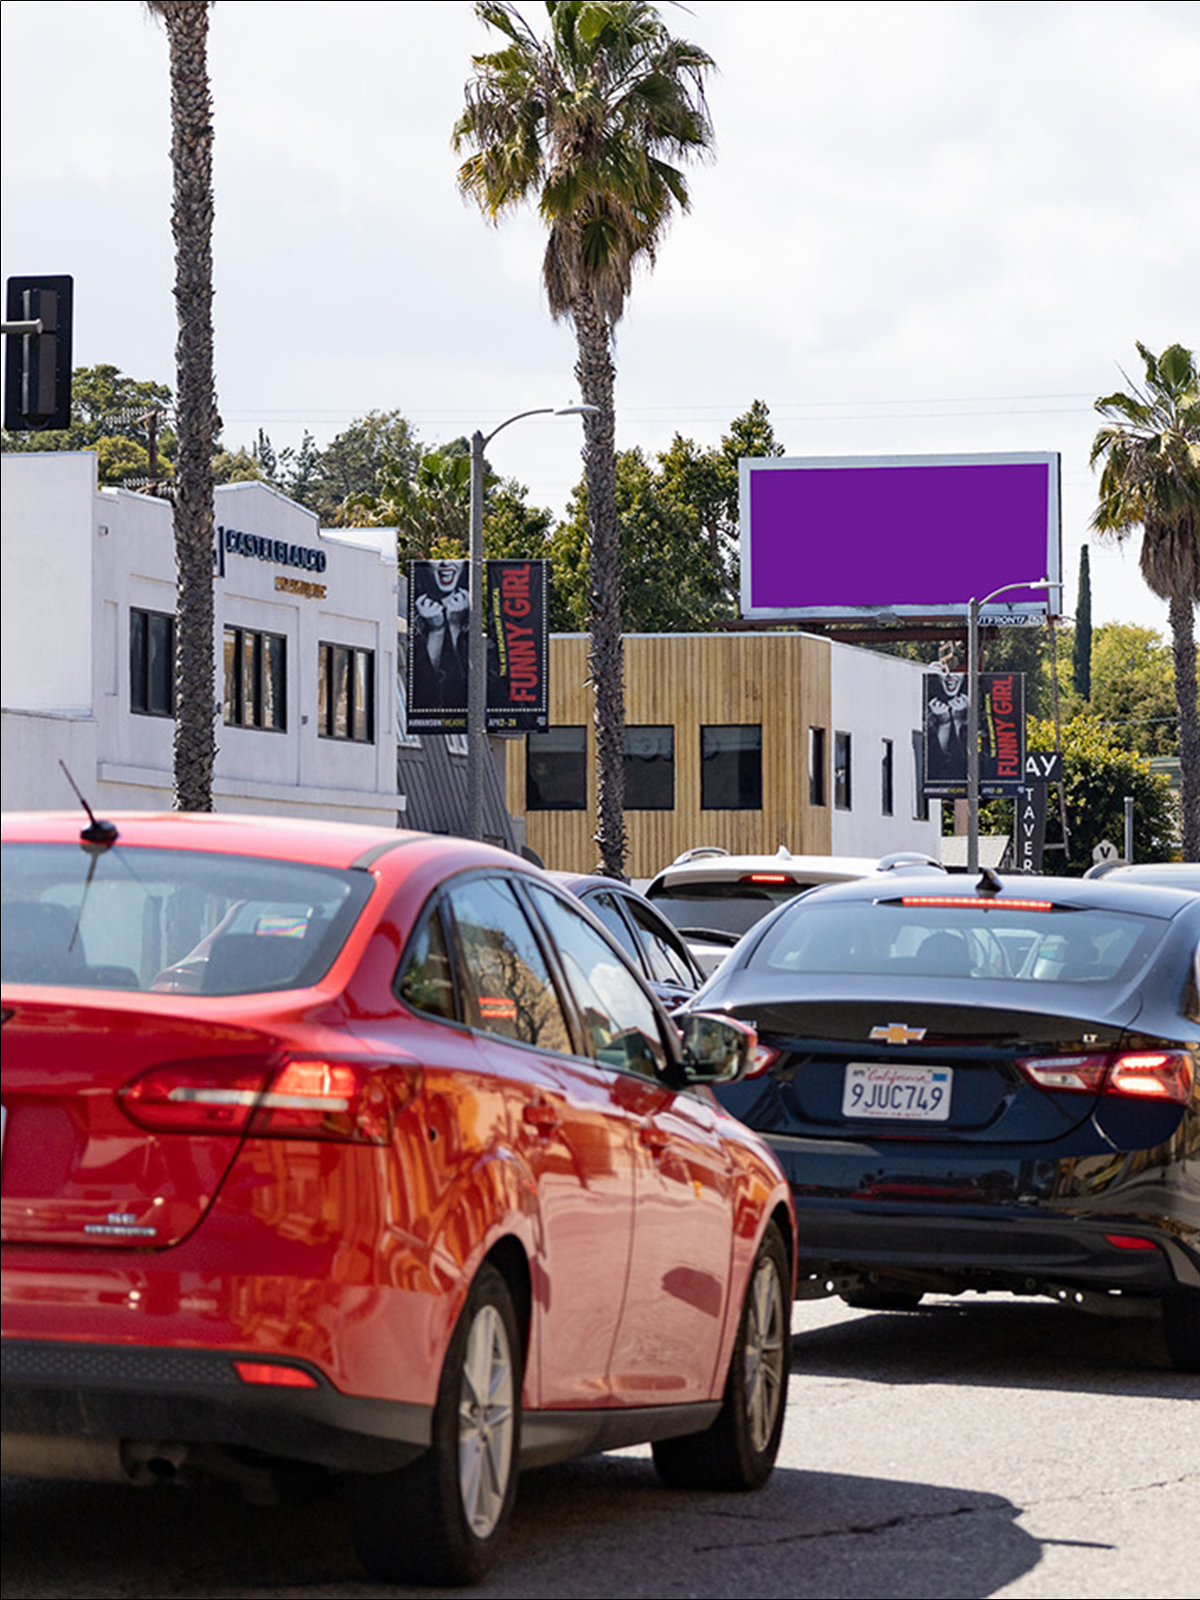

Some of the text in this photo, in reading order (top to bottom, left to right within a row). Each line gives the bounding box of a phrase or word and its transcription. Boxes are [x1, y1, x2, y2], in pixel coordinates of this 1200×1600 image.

[502, 563, 539, 702] FUNNY GIRL
[992, 675, 1019, 776] FUNNY GIRL
[1025, 755, 1057, 777] AY
[867, 1067, 927, 1086] California
[850, 1083, 943, 1111] 9JUC749
